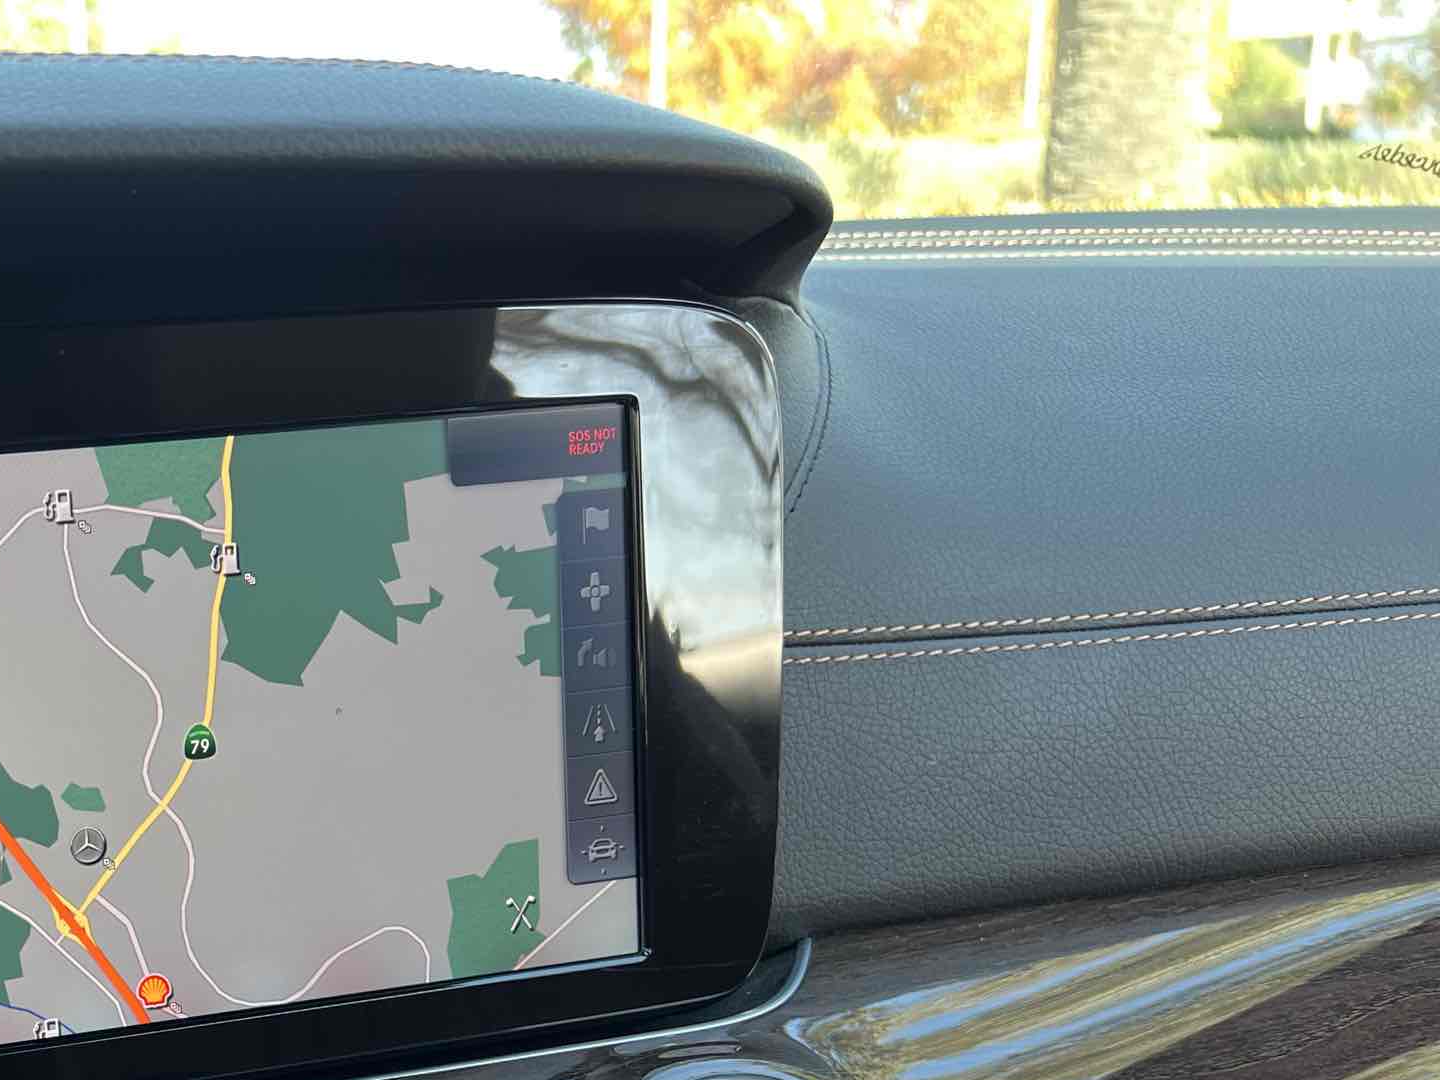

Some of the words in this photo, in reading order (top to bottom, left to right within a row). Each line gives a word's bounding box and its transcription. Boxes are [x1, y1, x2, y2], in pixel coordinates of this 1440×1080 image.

[568, 430, 591, 442] SOS
[593, 426, 617, 441] NOT
[568, 441, 605, 456] READY
[190, 738, 210, 755] 79
